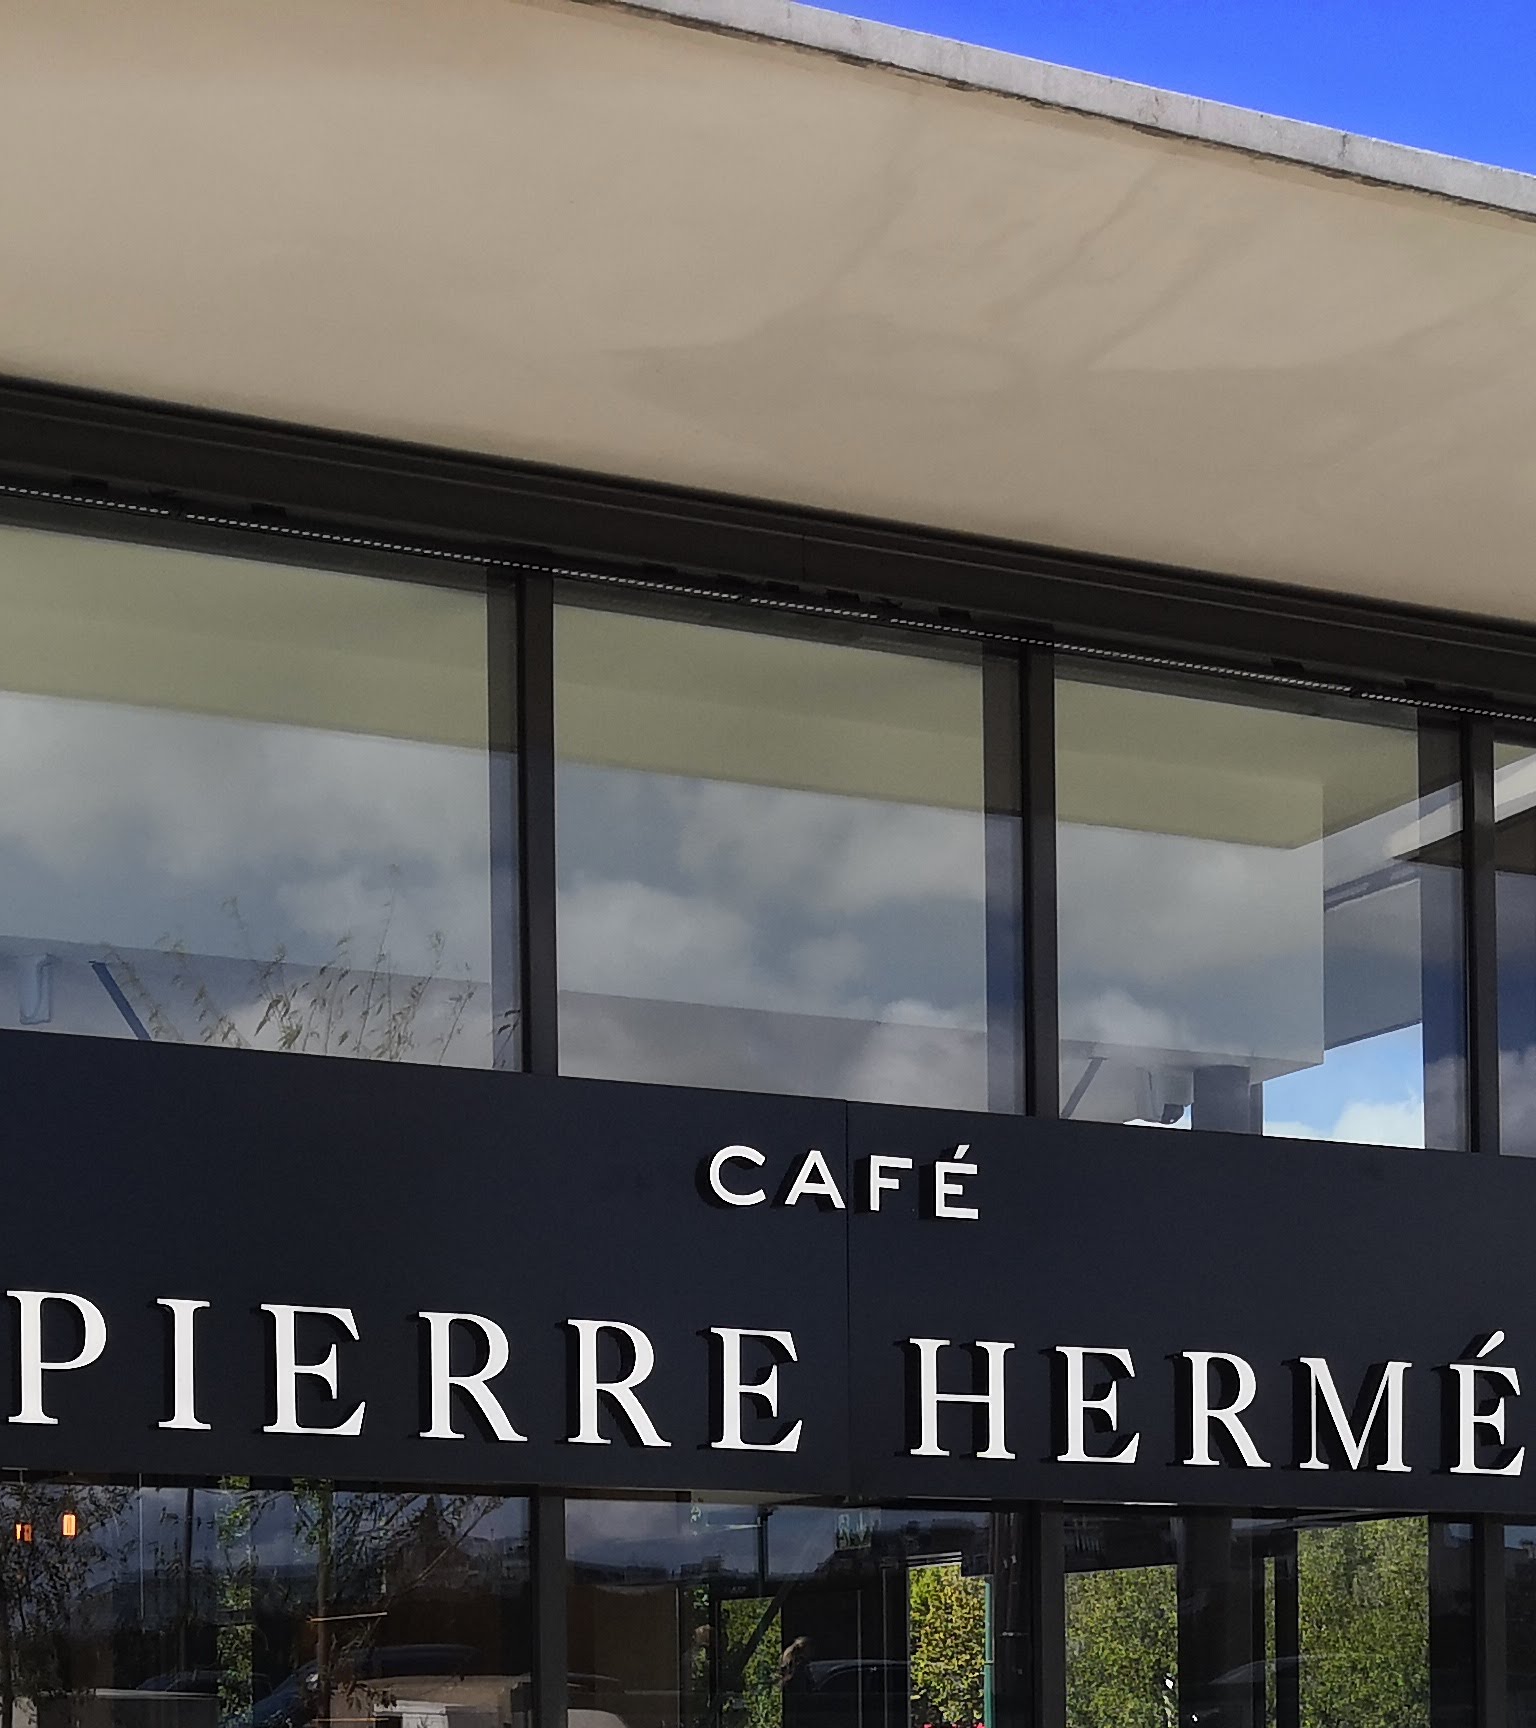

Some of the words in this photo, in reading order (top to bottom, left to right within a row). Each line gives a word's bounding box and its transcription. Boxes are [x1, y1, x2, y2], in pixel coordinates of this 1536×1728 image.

[707, 1143, 980, 1221] CAFÉ
[7, 1289, 803, 1454] PIERRE
[908, 1329, 1527, 1477] HERMÉ
